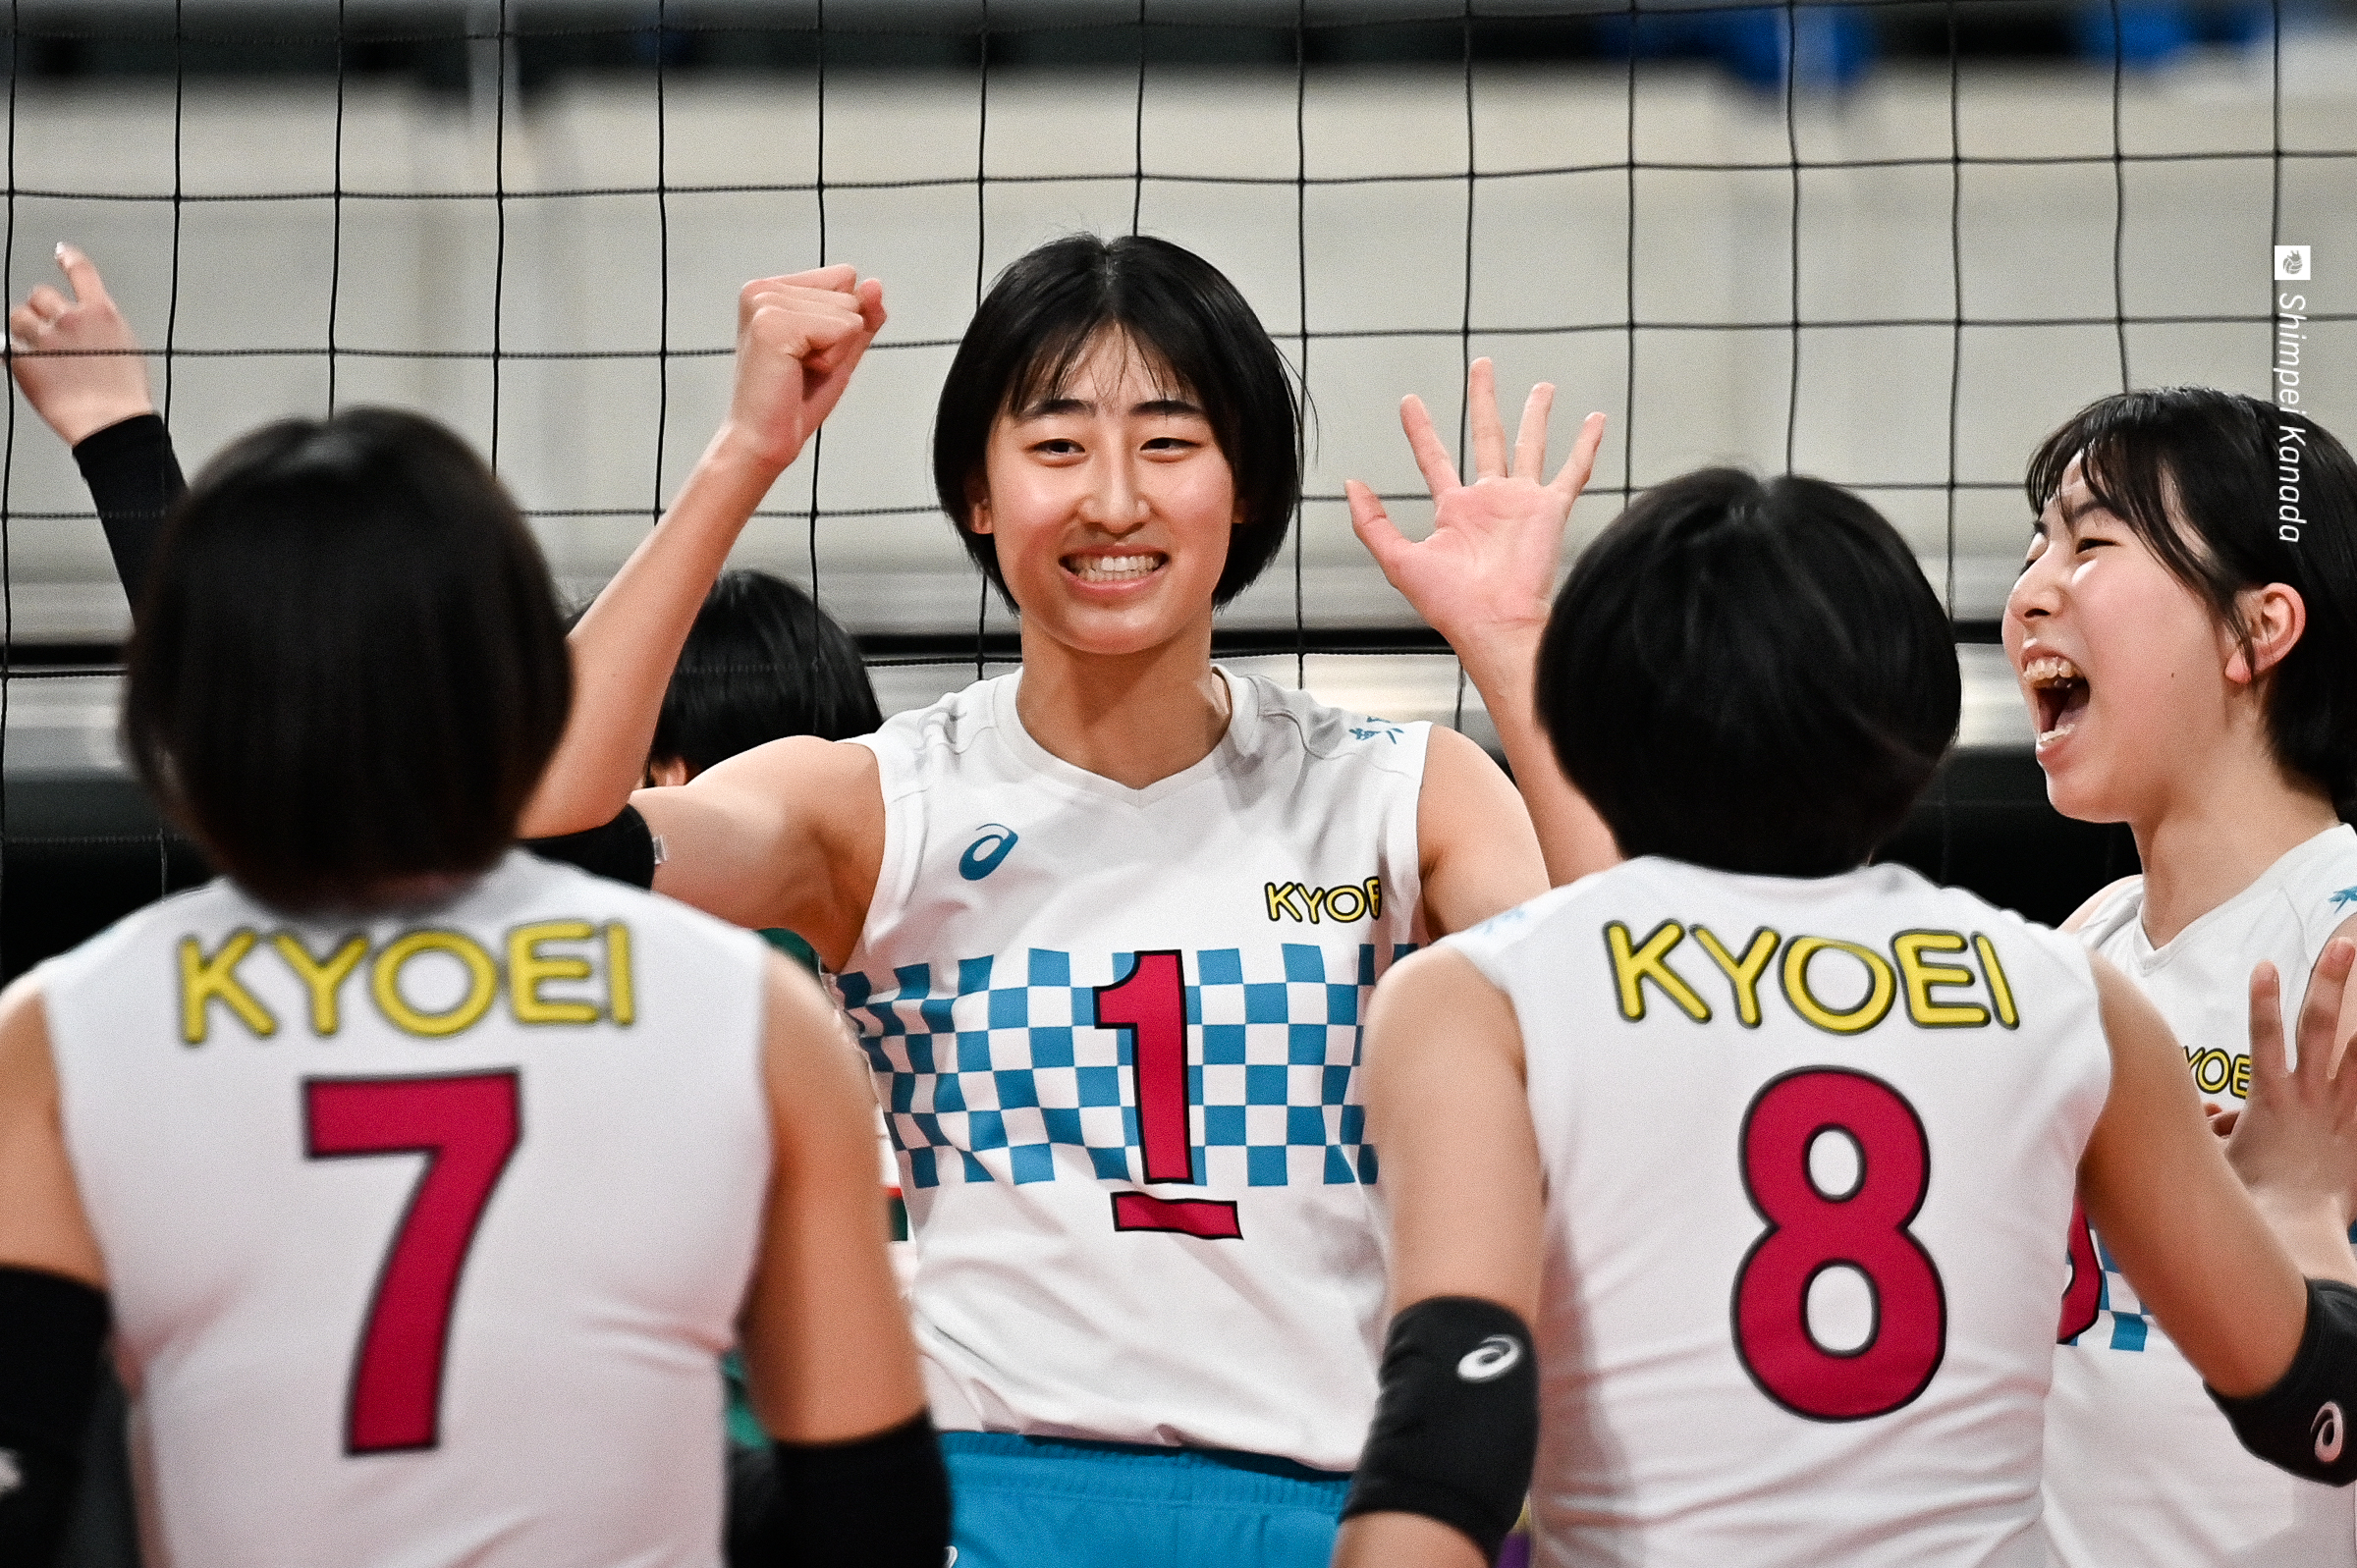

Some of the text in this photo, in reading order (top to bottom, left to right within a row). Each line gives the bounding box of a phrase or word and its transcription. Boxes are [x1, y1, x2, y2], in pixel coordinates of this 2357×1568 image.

[179, 920, 636, 1046] KYOEI
[1092, 949, 1195, 1185] 1
[1602, 918, 2020, 1036] KYOEI
[301, 1066, 523, 1458] 7
[1730, 1065, 1947, 1423] 8
